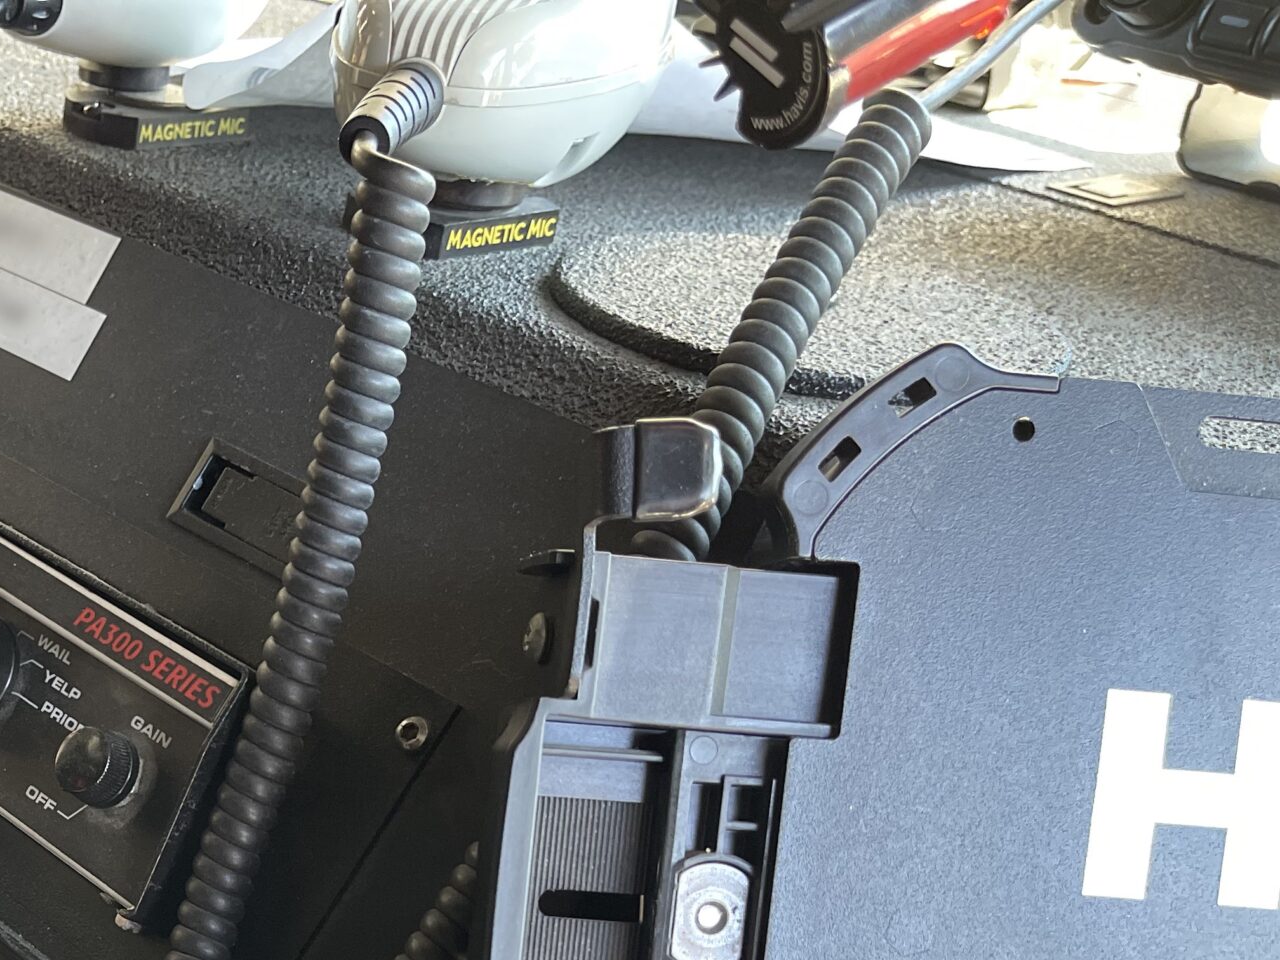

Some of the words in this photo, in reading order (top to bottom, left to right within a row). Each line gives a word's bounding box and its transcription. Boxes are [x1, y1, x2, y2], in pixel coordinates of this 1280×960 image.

[750, 41, 813, 131] www.havis.com
[139, 121, 216, 144] MAGNETIC
[218, 117, 246, 136] MIC
[446, 222, 526, 251] MAGNETIC
[526, 218, 556, 240] MIC
[37, 633, 72, 666] WAIL
[73, 607, 144, 661] PA300
[141, 649, 222, 709] SERIES
[43, 671, 82, 700] YELP
[41, 701, 85, 732] PRIO
[130, 715, 173, 750] GAIN
[25, 784, 58, 812] OFF
